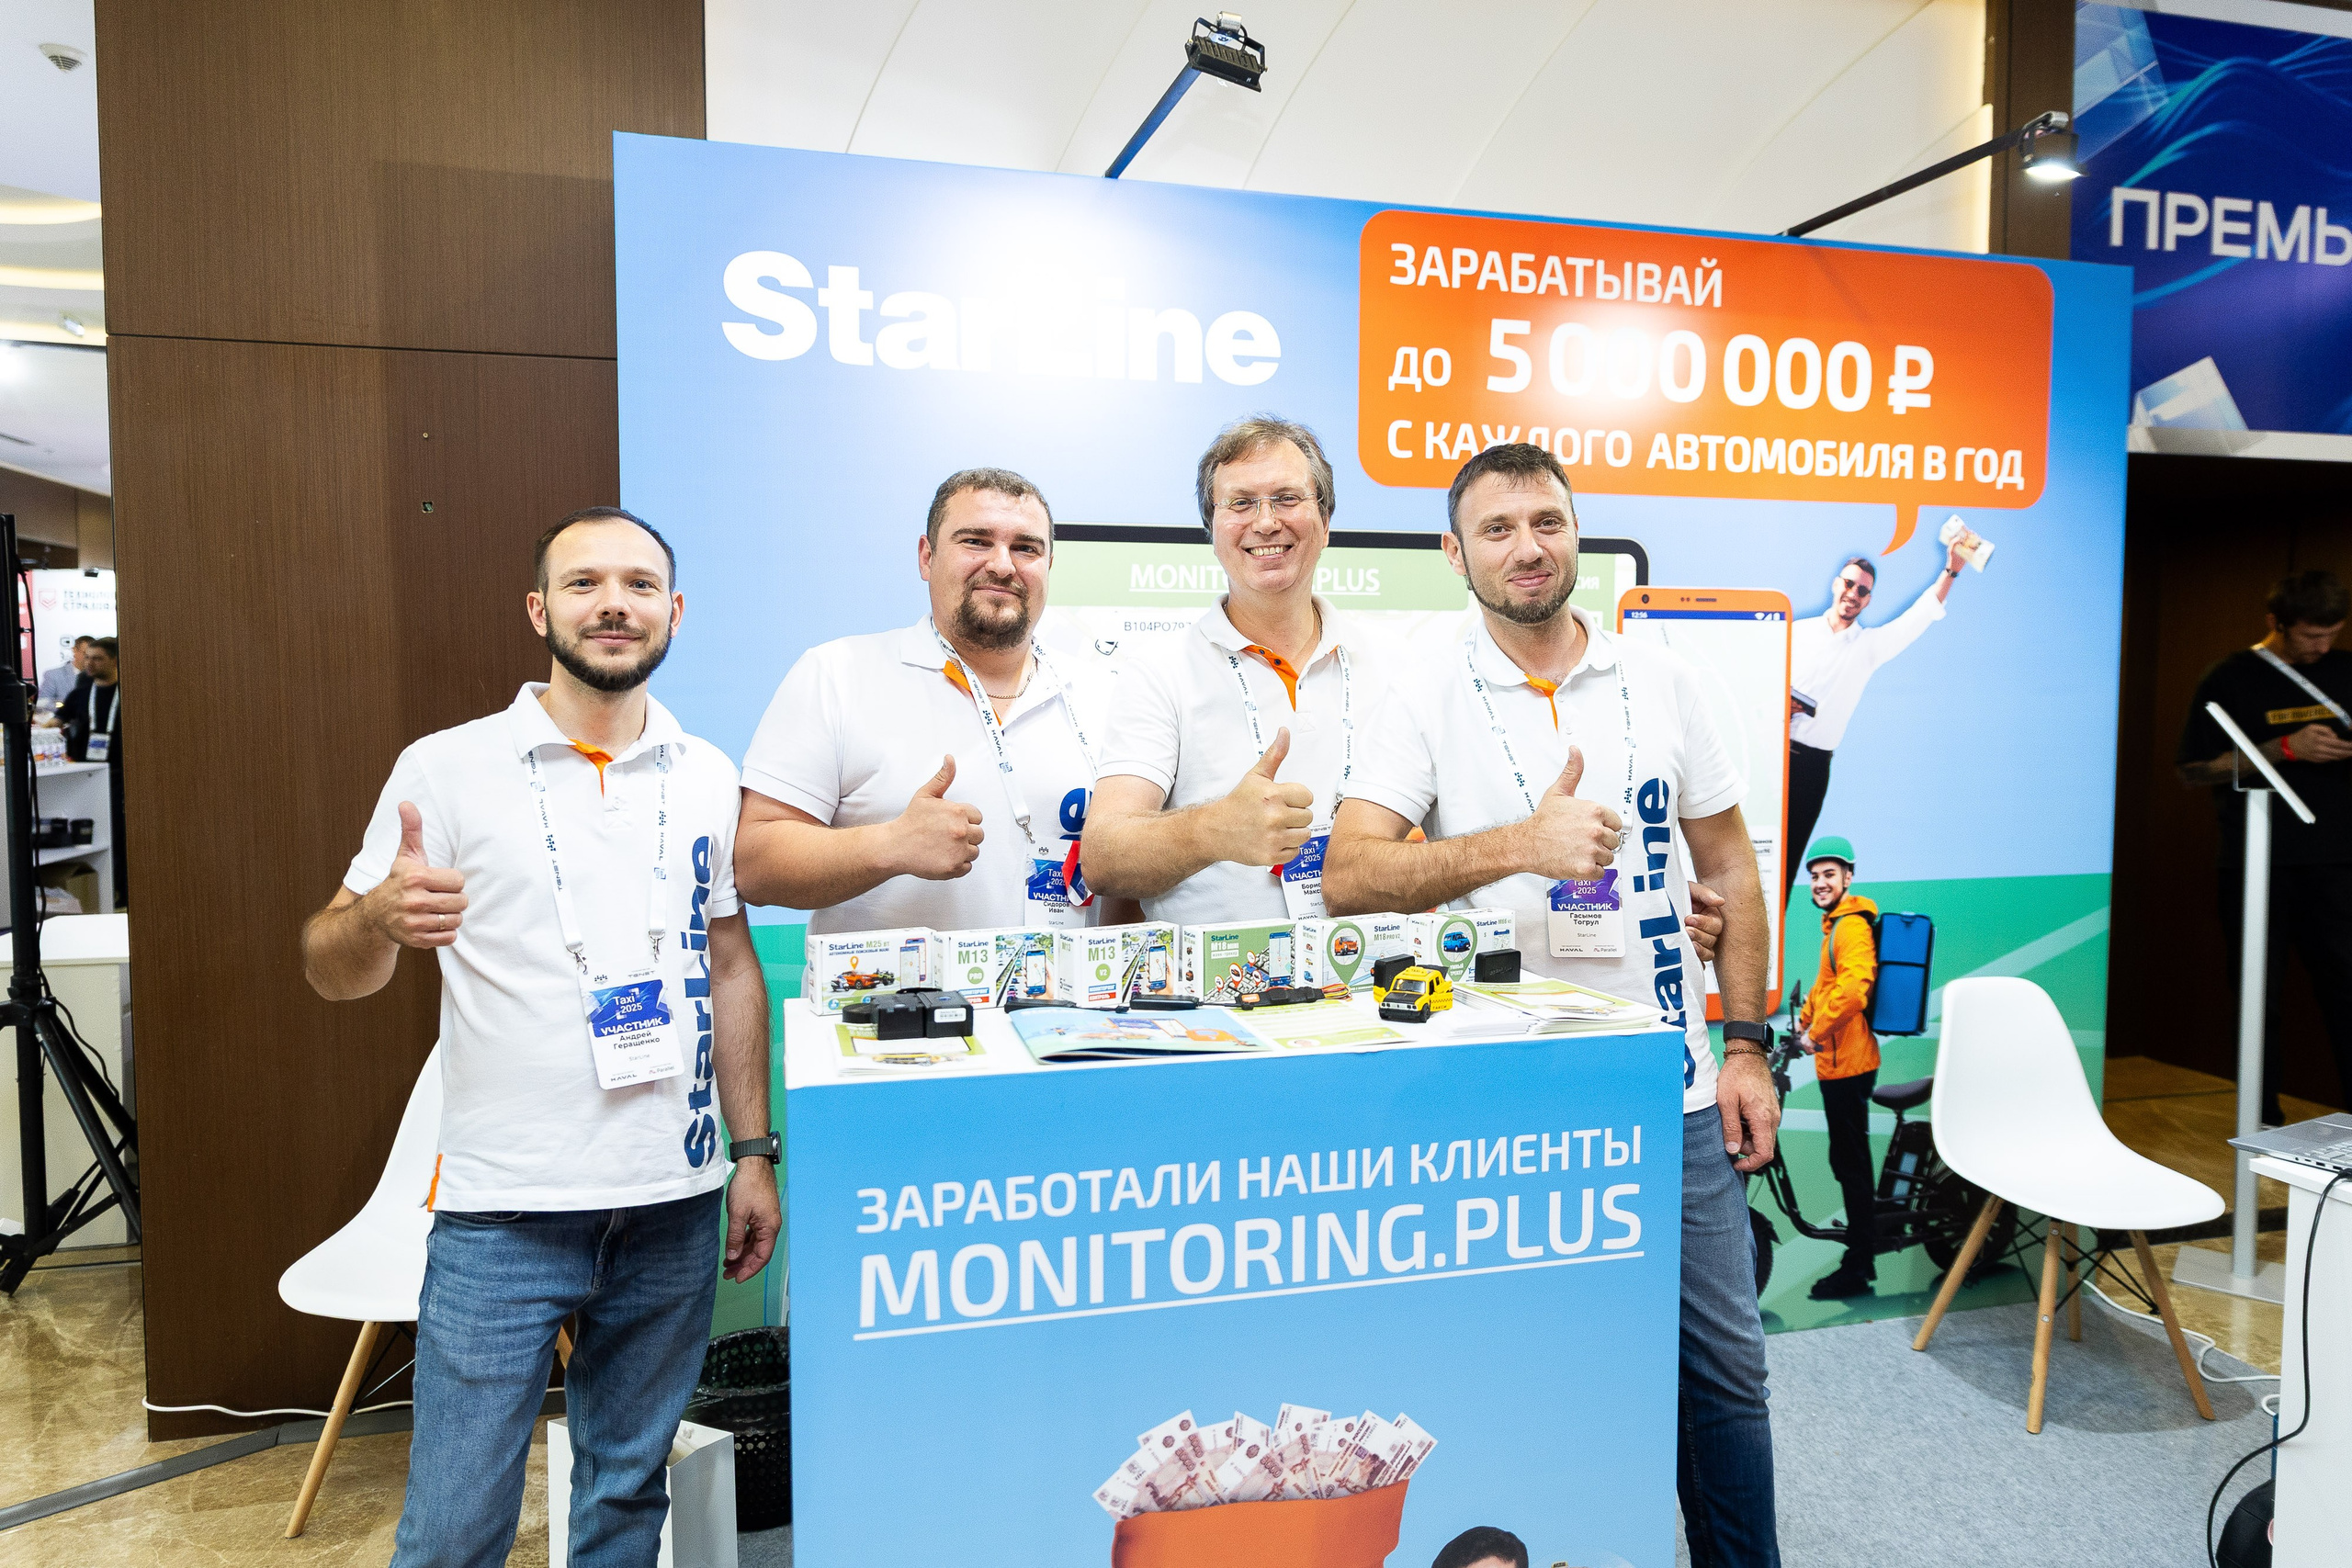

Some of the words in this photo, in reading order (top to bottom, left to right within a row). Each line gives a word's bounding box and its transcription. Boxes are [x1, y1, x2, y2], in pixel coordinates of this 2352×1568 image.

[2109, 186, 2352, 266] ПРЕМЬ
[1389, 243, 1724, 308] ЗАРАБАТЫВАЙ
[1388, 345, 1453, 392] ДО
[1486, 317, 1532, 393] 5
[1724, 333, 1872, 412] 000
[1387, 419, 1413, 460] С
[1646, 434, 1915, 479] АВТОМОБИЛЯ
[1923, 446, 1947, 479] В
[1955, 446, 2025, 490] ГОД
[1238, 672, 1249, 696] HAVAL
[1482, 695, 1495, 721] HAVAL
[991, 729, 1003, 757] HAVAL
[1524, 792, 1535, 814] HAVA
[1299, 846, 1316, 855] Taxi
[1304, 853, 1321, 863] 2025
[1289, 869, 1323, 881] УЧАСТН
[1033, 892, 1069, 902] УЧАСТН
[1577, 886, 1597, 895] 2025
[1043, 900, 1070, 908] Сидоров
[1557, 902, 1613, 911] УЧАСТНИК
[1374, 924, 1400, 932] StarLine
[1088, 937, 1116, 945] StarLine
[1374, 932, 1385, 942] M18
[829, 942, 864, 952] StarLine
[1088, 946, 1115, 961] M13
[1211, 942, 1227, 952] M18
[957, 949, 989, 964] M13
[613, 993, 636, 1006] Taxi
[681, 835, 717, 1169] StarLine
[620, 1002, 643, 1014] 2025
[600, 1016, 664, 1036] УЧАСТНИК
[619, 1031, 652, 1042] Андрей
[614, 1037, 661, 1050] Геращенко
[855, 1159, 1221, 1234] ЗАРАБОТАЛИ
[1238, 1146, 1395, 1201] НАШИ
[1409, 1125, 1643, 1183] КЛИЕНТЫ
[858, 1183, 1644, 1330] MONITORING.PLUS
